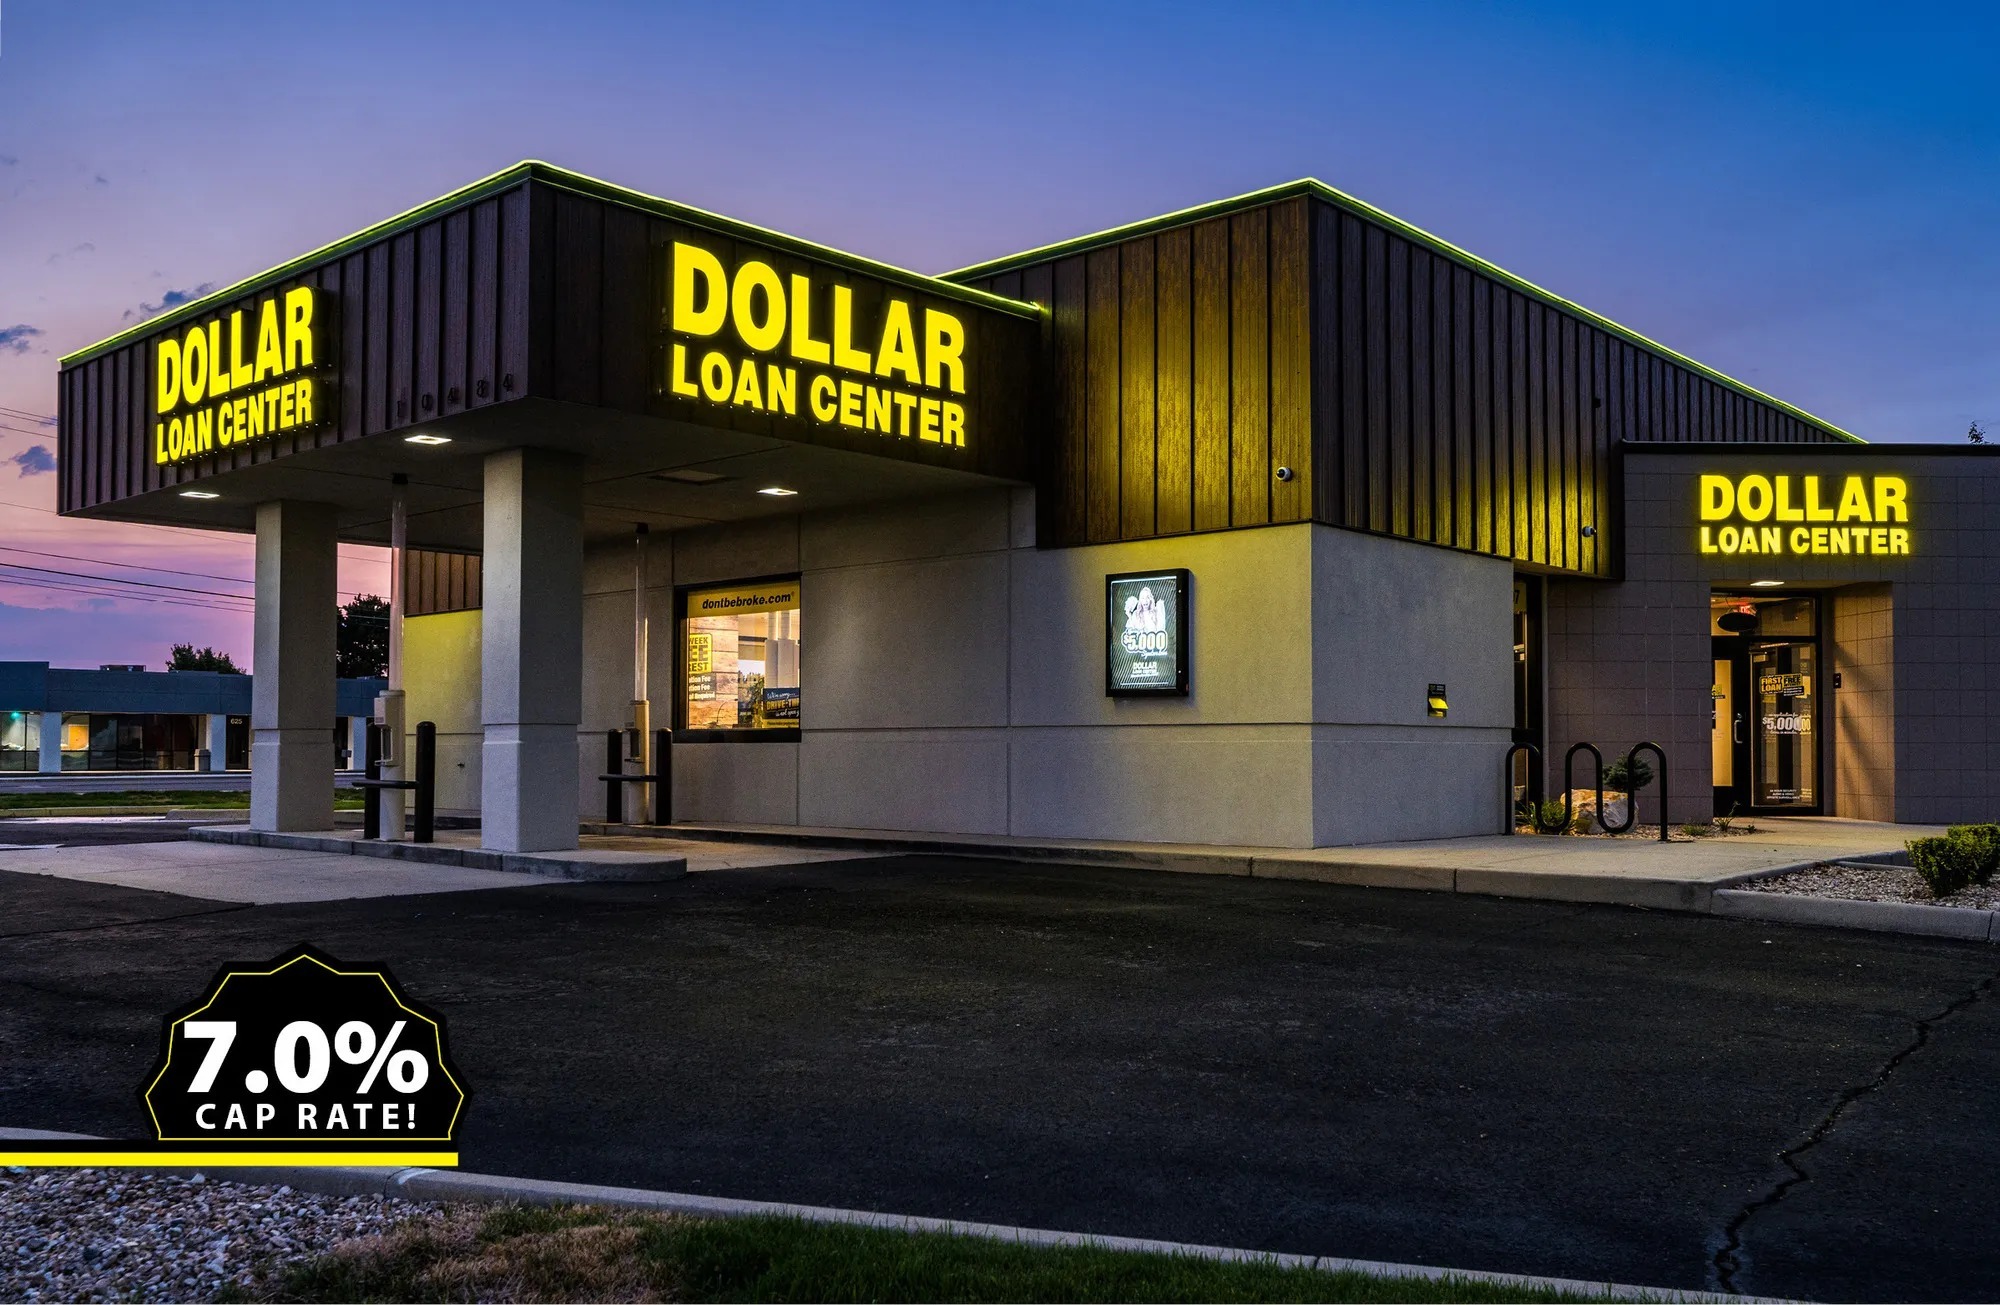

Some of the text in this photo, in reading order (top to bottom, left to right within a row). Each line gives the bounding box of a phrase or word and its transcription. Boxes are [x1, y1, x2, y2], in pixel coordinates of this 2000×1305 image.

[673, 241, 966, 394] DOLLAR
[157, 286, 313, 414] DOLLAR
[672, 344, 966, 447] LOAN CENTER
[156, 378, 313, 465] LOAN CENTER
[1700, 474, 1909, 522] DOLLAR
[1700, 526, 1910, 555] LOAN CENTER
[702, 592, 791, 609] dontbebroke.com
[1761, 676, 1802, 685] FIRST FREE
[1761, 684, 1782, 692] LOAN
[230, 717, 243, 725] 625
[1762, 716, 1801, 731] $5,000
